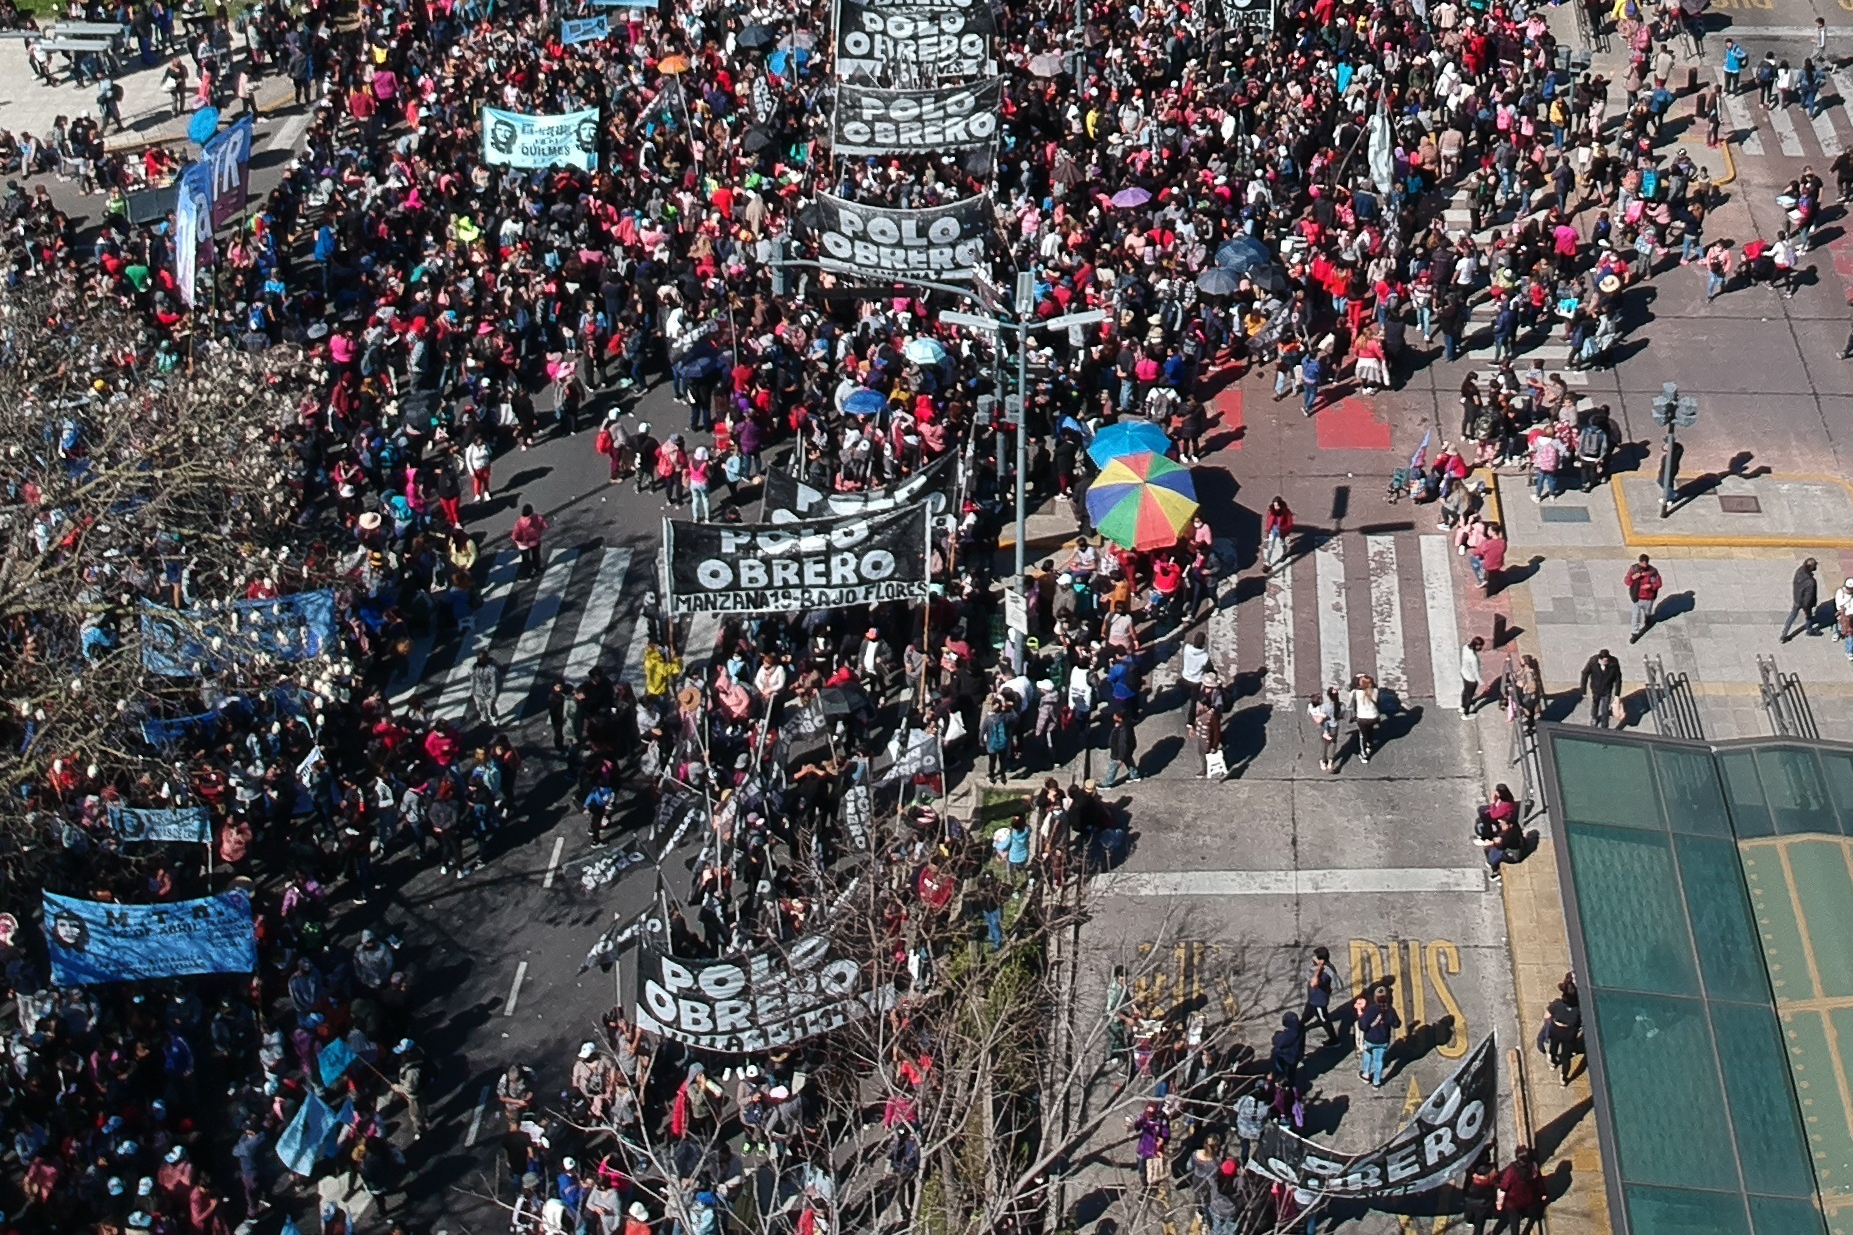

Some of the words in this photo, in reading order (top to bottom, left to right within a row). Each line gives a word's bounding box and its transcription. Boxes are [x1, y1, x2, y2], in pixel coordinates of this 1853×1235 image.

[862, 10, 966, 40] POLO
[844, 30, 984, 63] OBRERO
[860, 91, 976, 122] POLO
[842, 111, 997, 145] OBRERO
[521, 144, 571, 157] QUILMES
[838, 208, 961, 246] POLO
[821, 230, 985, 270] OBRERO
[720, 521, 869, 556] POLO
[696, 549, 897, 590] OBRERO
[863, 581, 928, 601] FLORES
